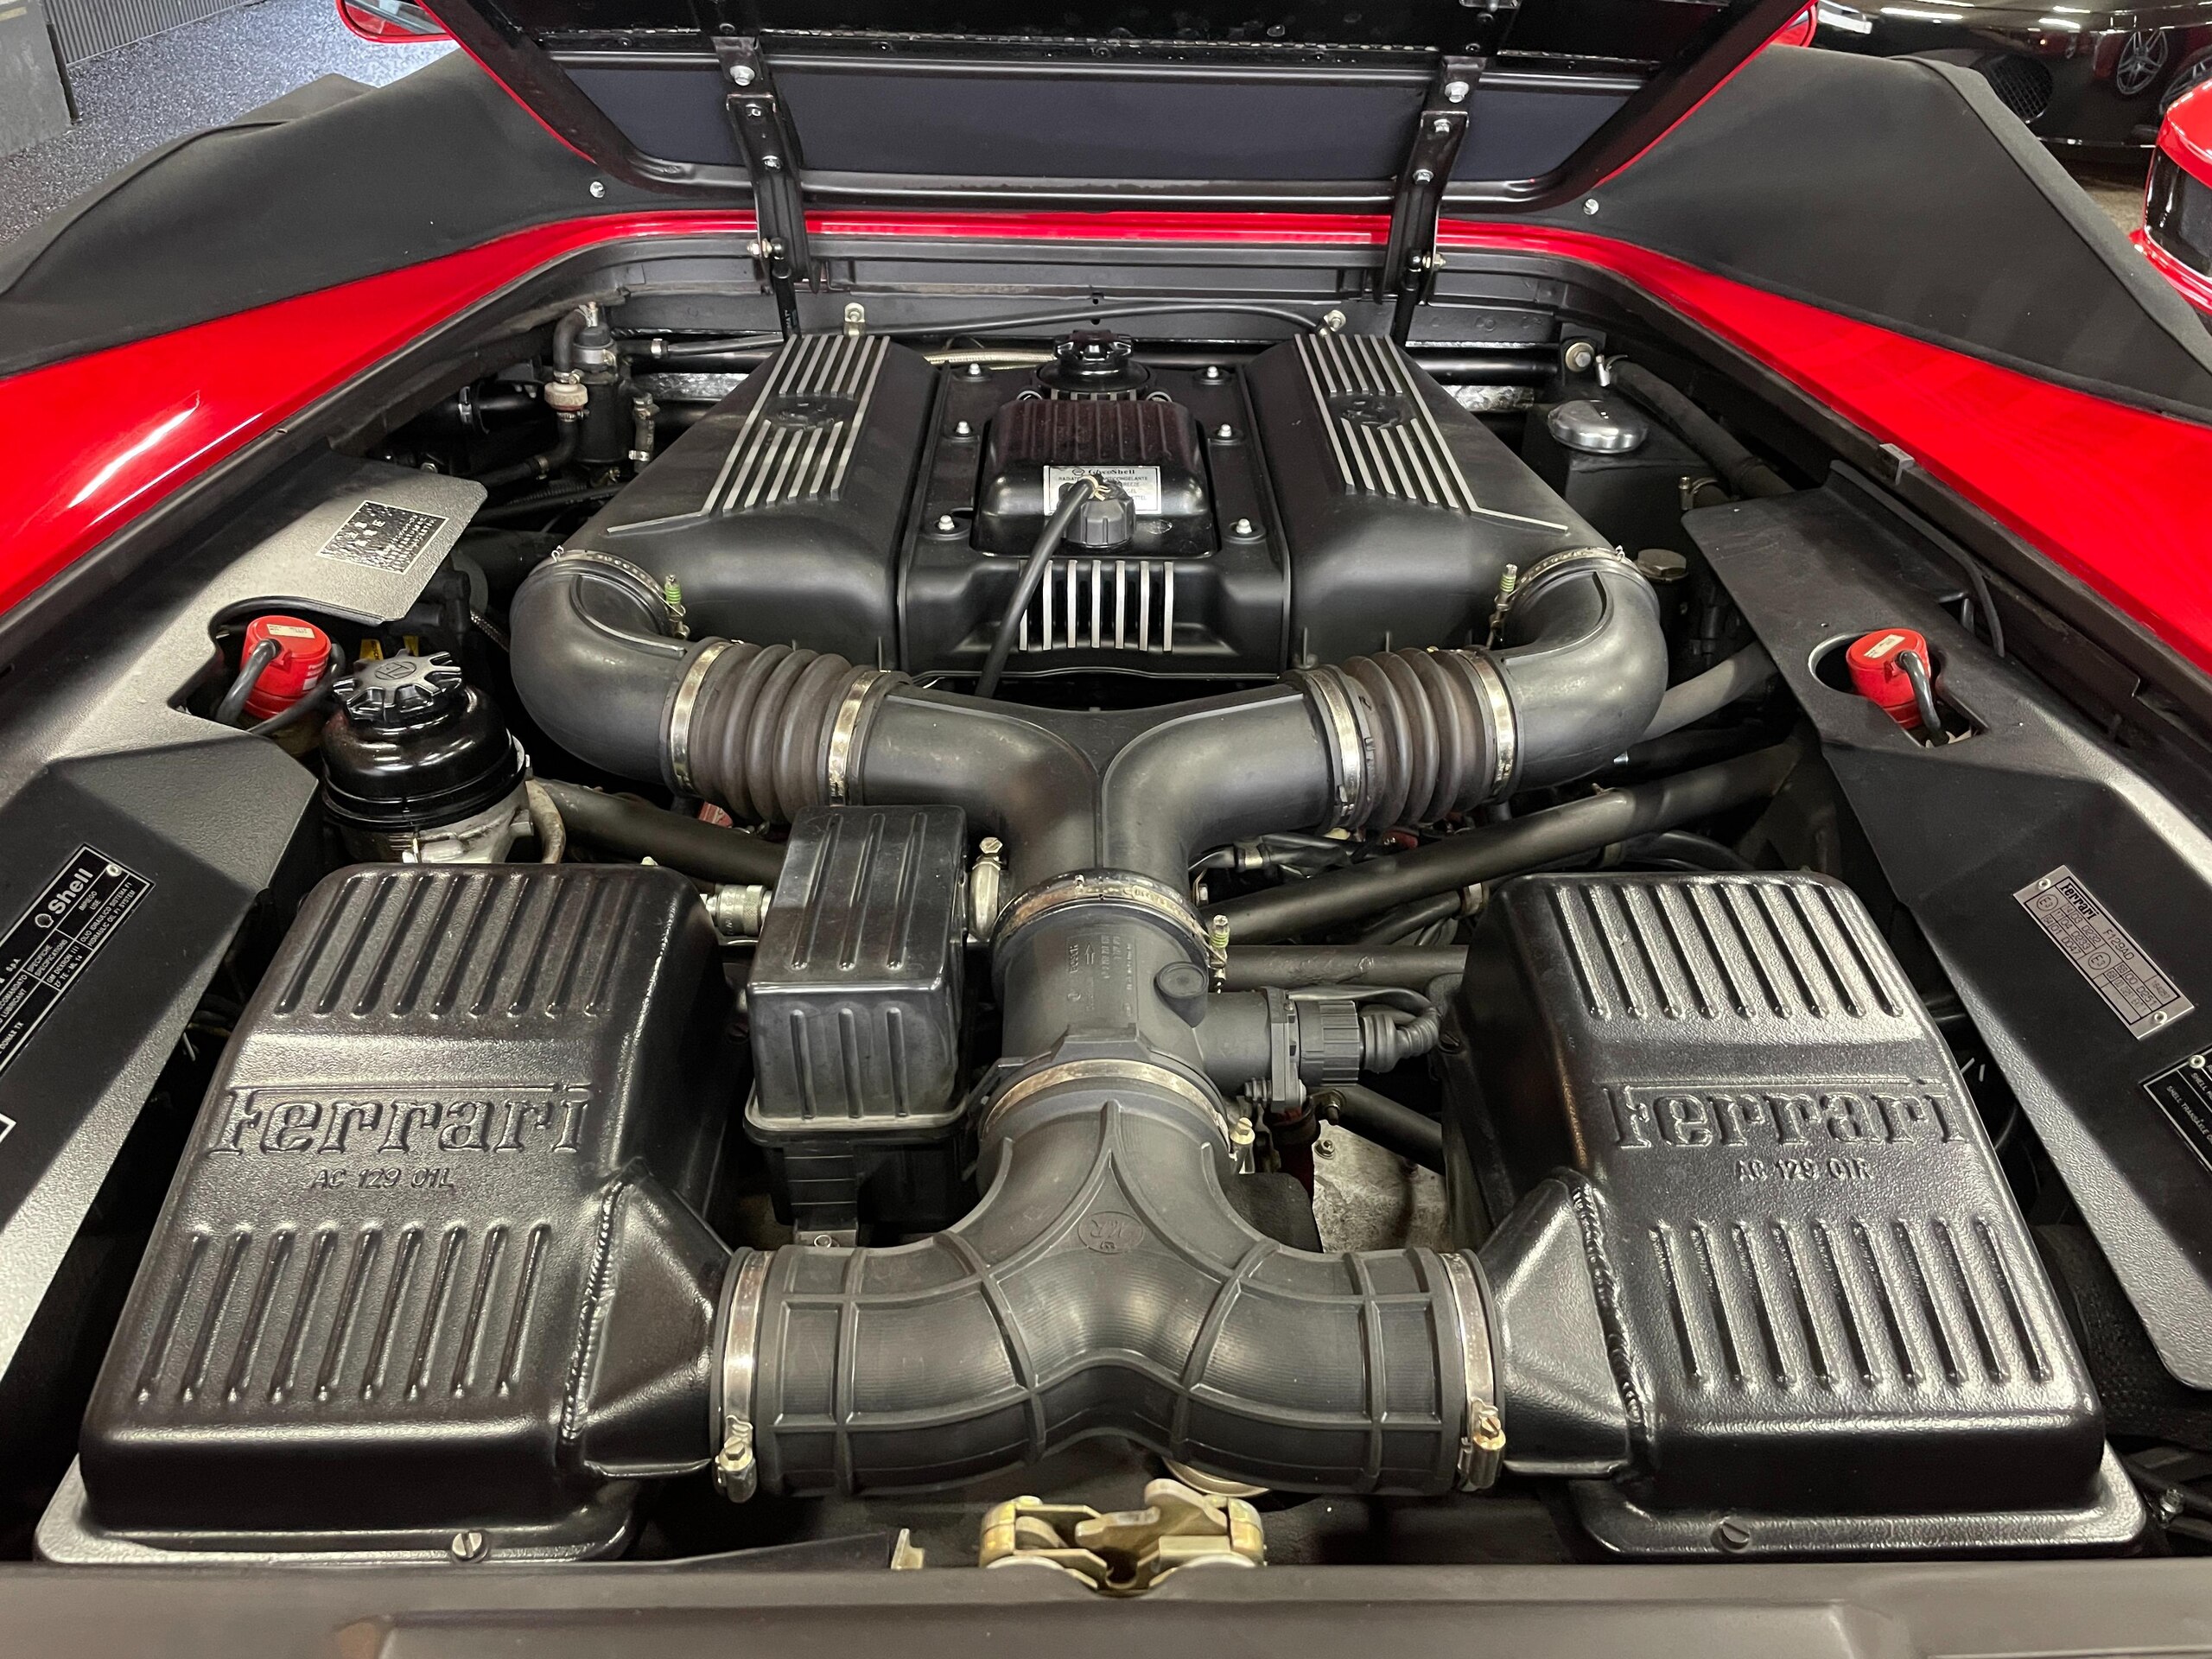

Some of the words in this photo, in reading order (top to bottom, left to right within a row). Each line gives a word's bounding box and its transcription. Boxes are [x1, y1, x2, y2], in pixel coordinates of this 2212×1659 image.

[48, 868, 92, 913] Shell
[79, 891, 97, 911] IMPIEGO
[118, 890, 135, 908] SYSTEM
[90, 899, 101, 910] USE
[90, 906, 111, 930] IDRAULICO
[109, 888, 127, 906] SISTEMA
[2060, 882, 2099, 919] Ferrari
[2102, 929, 2134, 960] F129AD
[27, 944, 52, 972] SPECIFICHE
[35, 939, 67, 976] SPECIFICATIONS
[54, 954, 73, 974] DEXRON
[2190, 1072, 2207, 1090] SHELL
[2166, 1085, 2182, 1103] SHELL
[209, 1083, 593, 1155] Ferrari
[1602, 1077, 1967, 1149] Ferrari
[311, 1168, 345, 1188] AC
[359, 1167, 398, 1187] 129
[1777, 1159, 1818, 1180] 129
